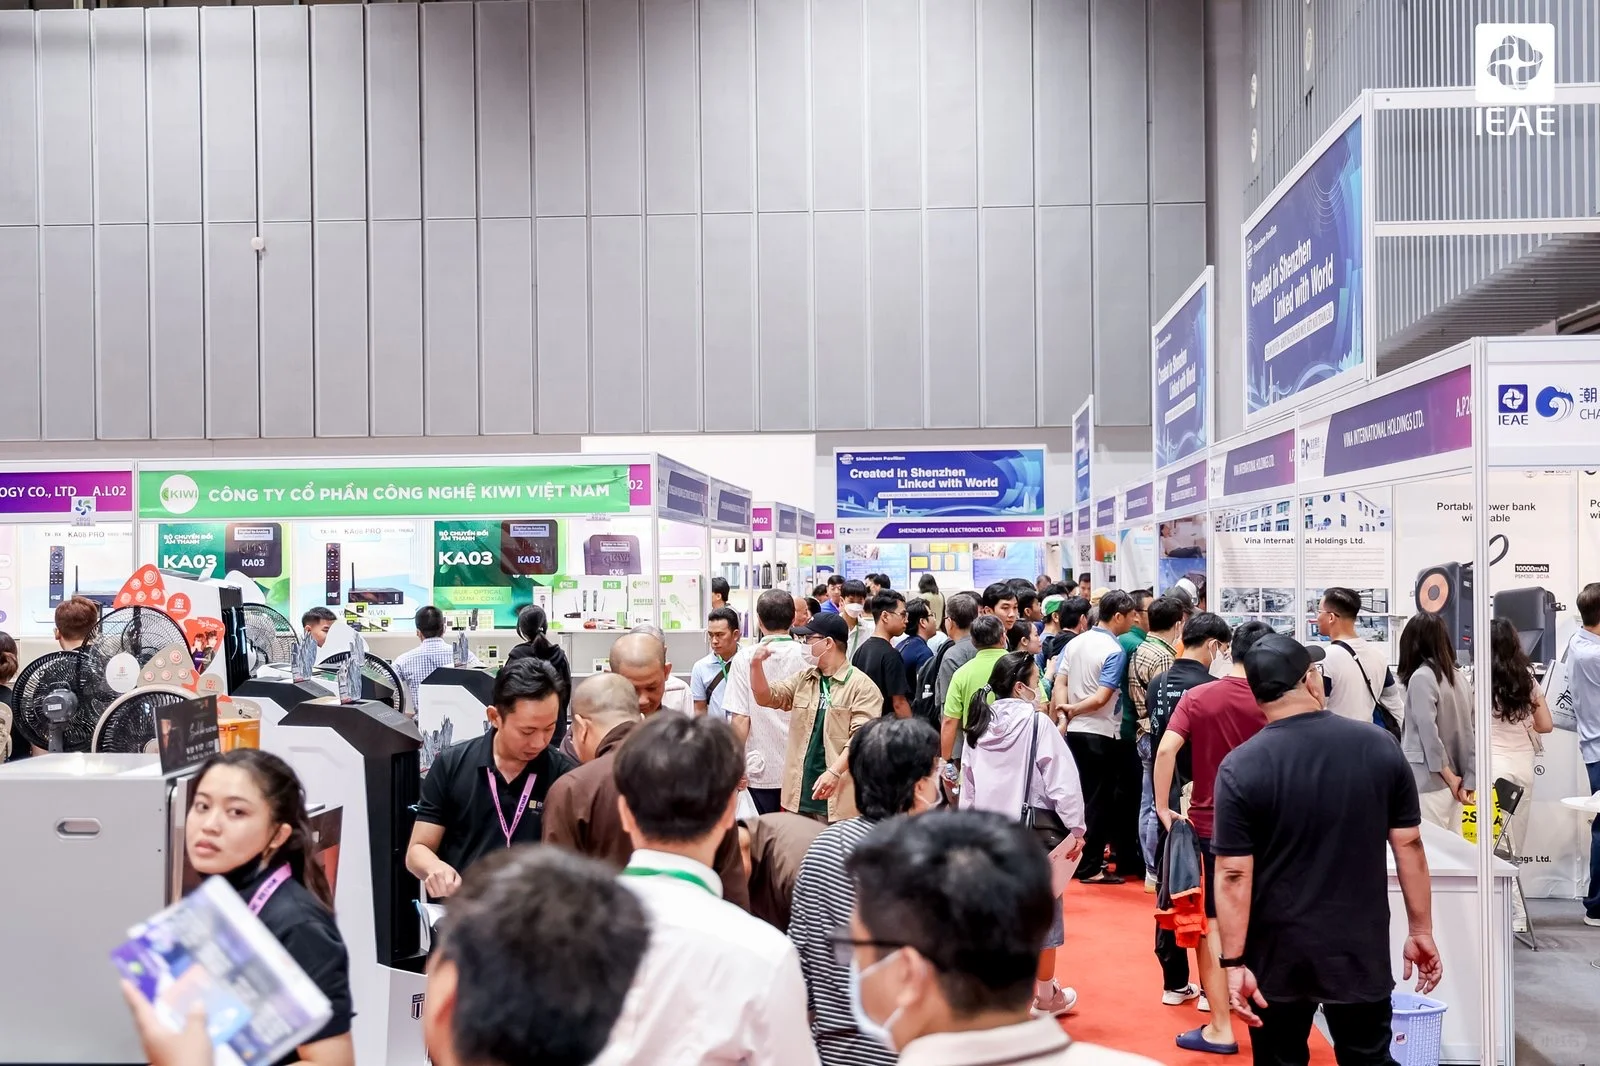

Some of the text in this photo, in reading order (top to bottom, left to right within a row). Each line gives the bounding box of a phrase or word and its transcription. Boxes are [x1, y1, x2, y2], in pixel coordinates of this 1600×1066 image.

[1251, 265, 1272, 307] Created
[1272, 263, 1279, 290] in
[1279, 238, 1311, 284] Shenzhen
[1273, 252, 1334, 325] Linked with World
[1498, 414, 1529, 426] IEAE
[1353, 420, 1387, 446] INTERNATIONAL
[1386, 412, 1413, 436] HOLDINGS
[1412, 409, 1425, 430] LTD.
[849, 467, 966, 479] Created in Shenzhen
[897, 477, 998, 489] Linked with World
[27, 486, 52, 499] CO.,
[54, 486, 77, 497] LTD
[92, 485, 127, 497] A.L02
[170, 489, 198, 499] KIWI
[208, 481, 610, 503] CÔNG TY CỔ PHẦN CÔNG NGHỆ KIWI VIỆT NAM
[1512, 502, 1536, 511] bank
[1490, 514, 1510, 522] able
[1314, 537, 1348, 545] Holdings
[163, 554, 217, 569] KA03
[241, 559, 265, 567] KA03
[438, 551, 493, 566] KA03
[517, 555, 541, 564] KA03
[1536, 855, 1552, 863] Ltd.
